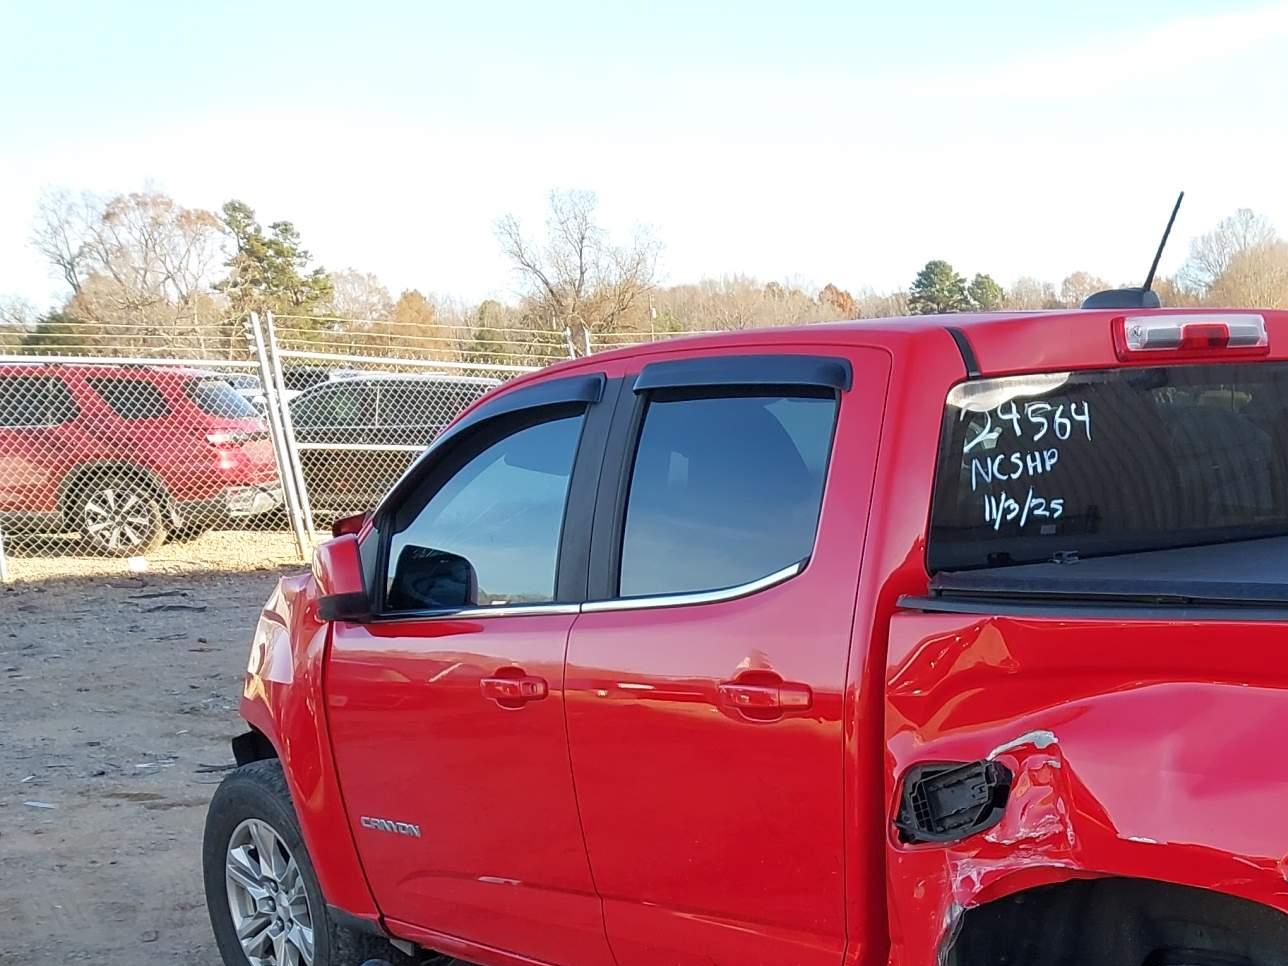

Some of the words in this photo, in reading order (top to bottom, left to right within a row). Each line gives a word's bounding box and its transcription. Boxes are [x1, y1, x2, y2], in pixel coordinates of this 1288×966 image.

[971, 448, 1058, 491] NCSHP
[984, 486, 1064, 531] 11/3/25
[360, 815, 421, 838] CANYON
